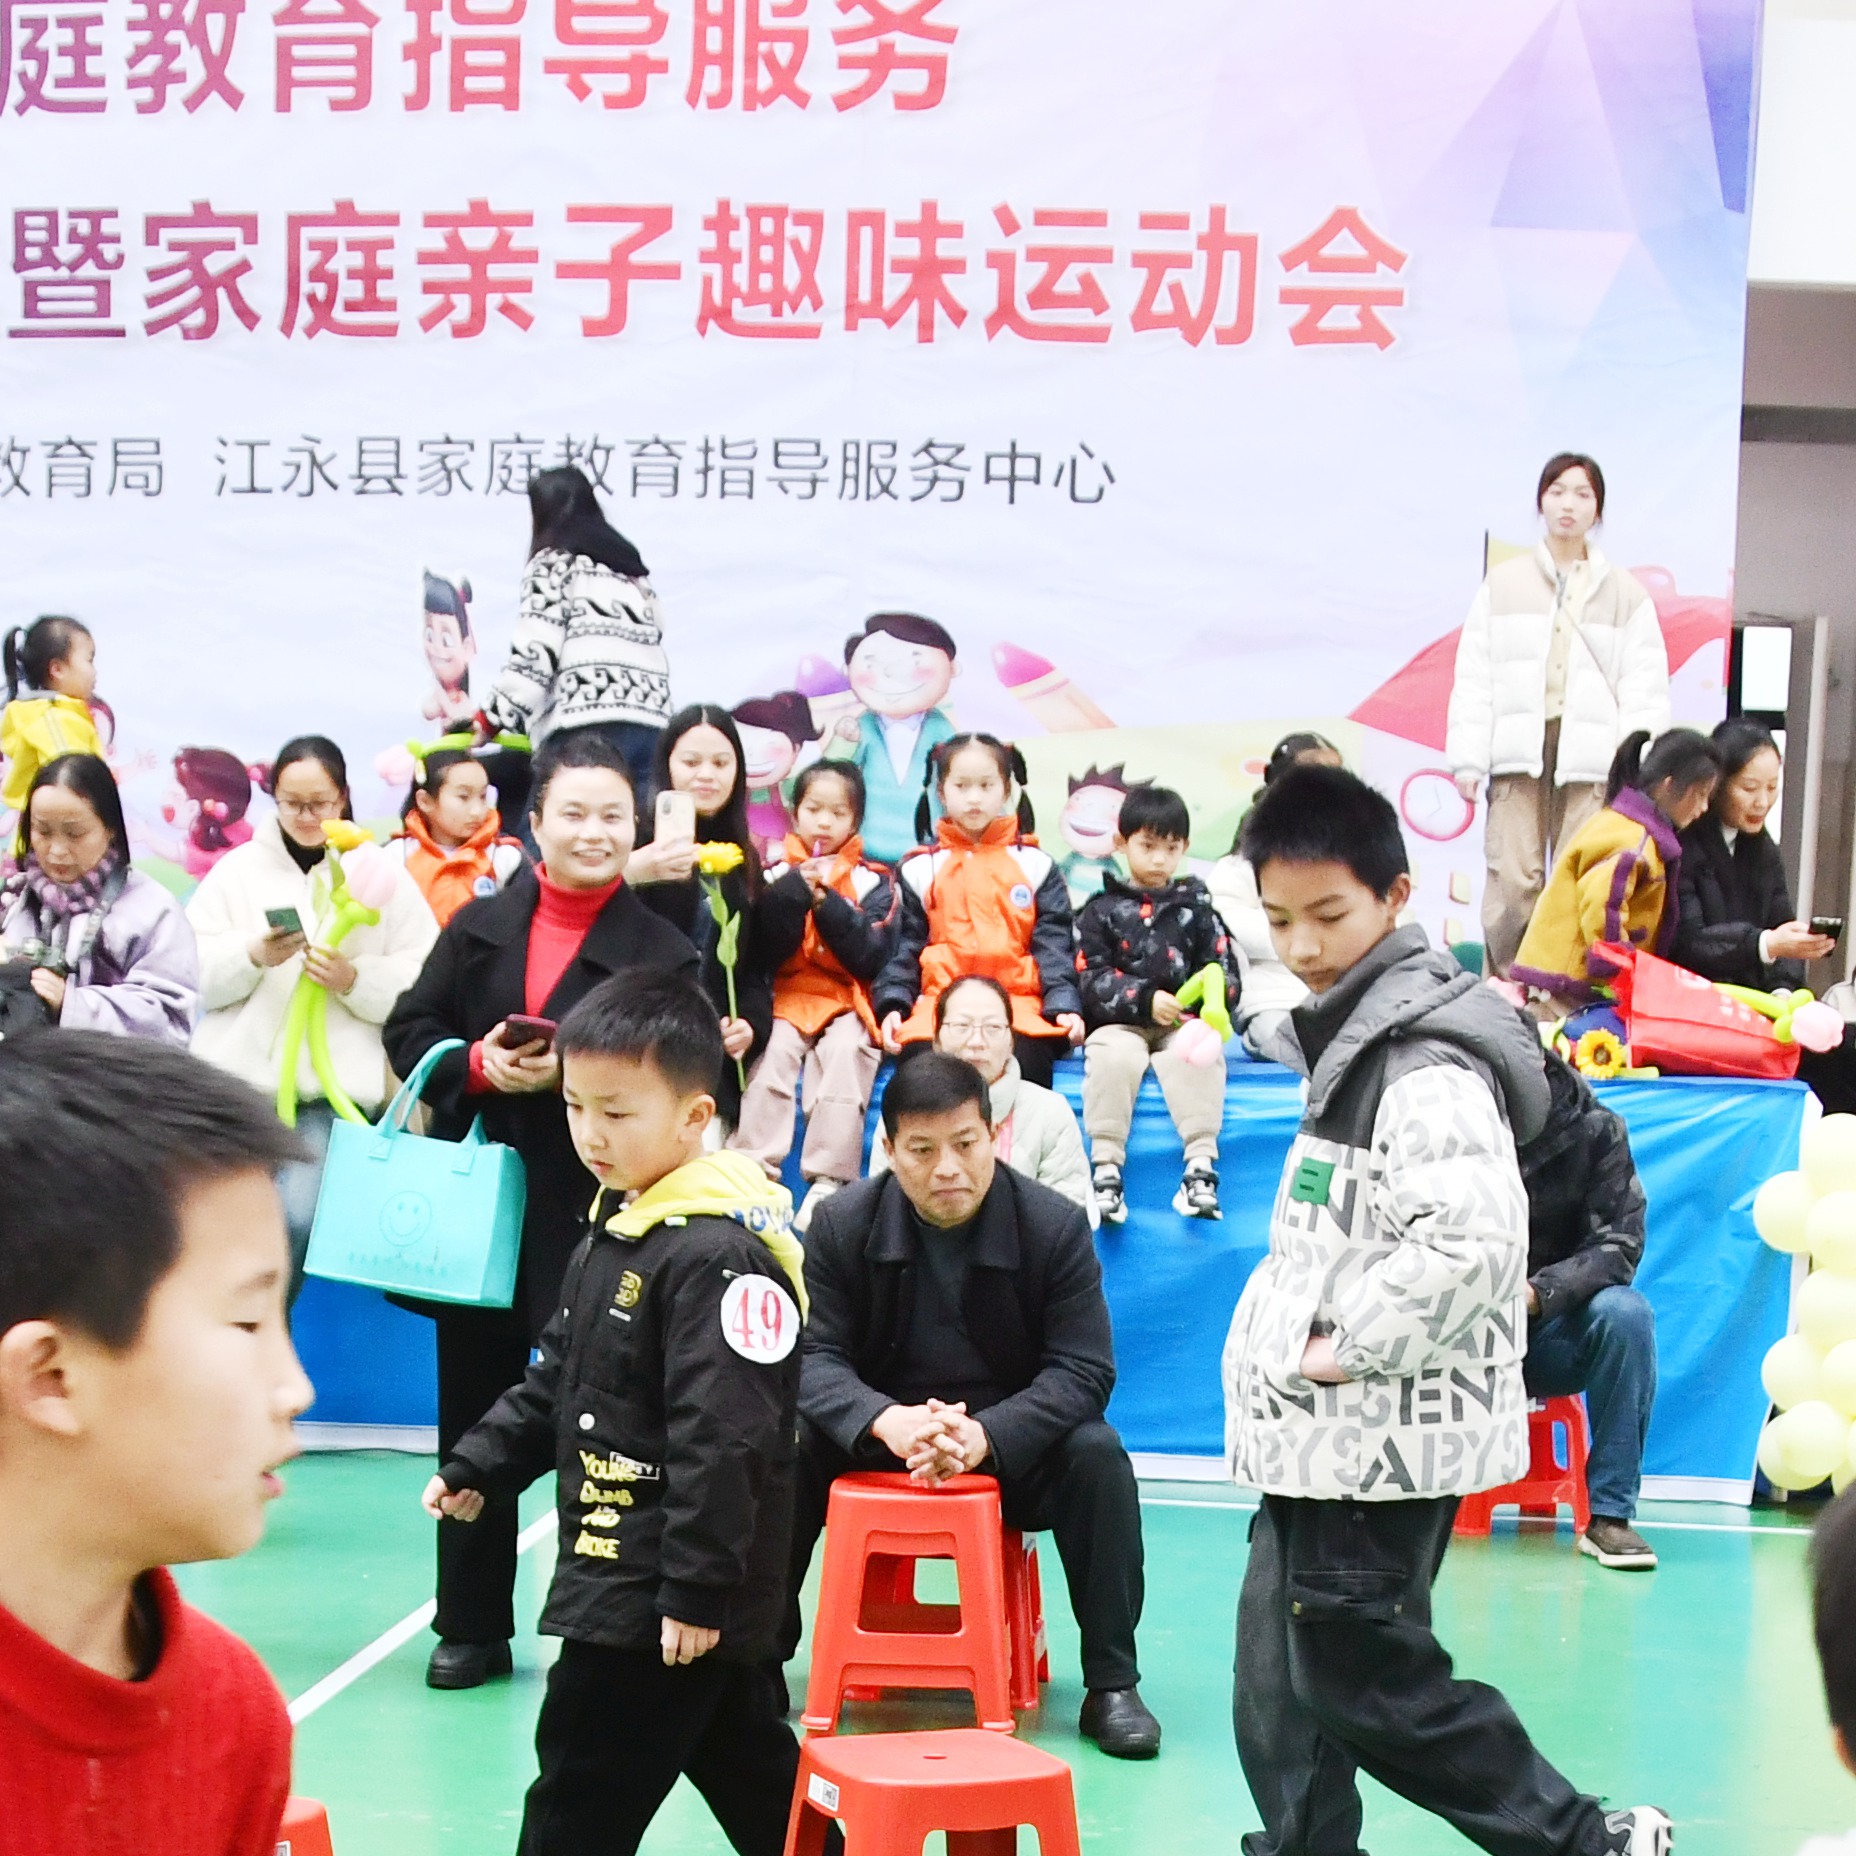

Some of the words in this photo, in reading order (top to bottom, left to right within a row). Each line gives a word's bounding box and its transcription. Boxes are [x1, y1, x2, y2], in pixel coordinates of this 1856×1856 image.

[213, 432, 1116, 506] 江永县家庭教育指导服务中心
[731, 1287, 783, 1351] 49
